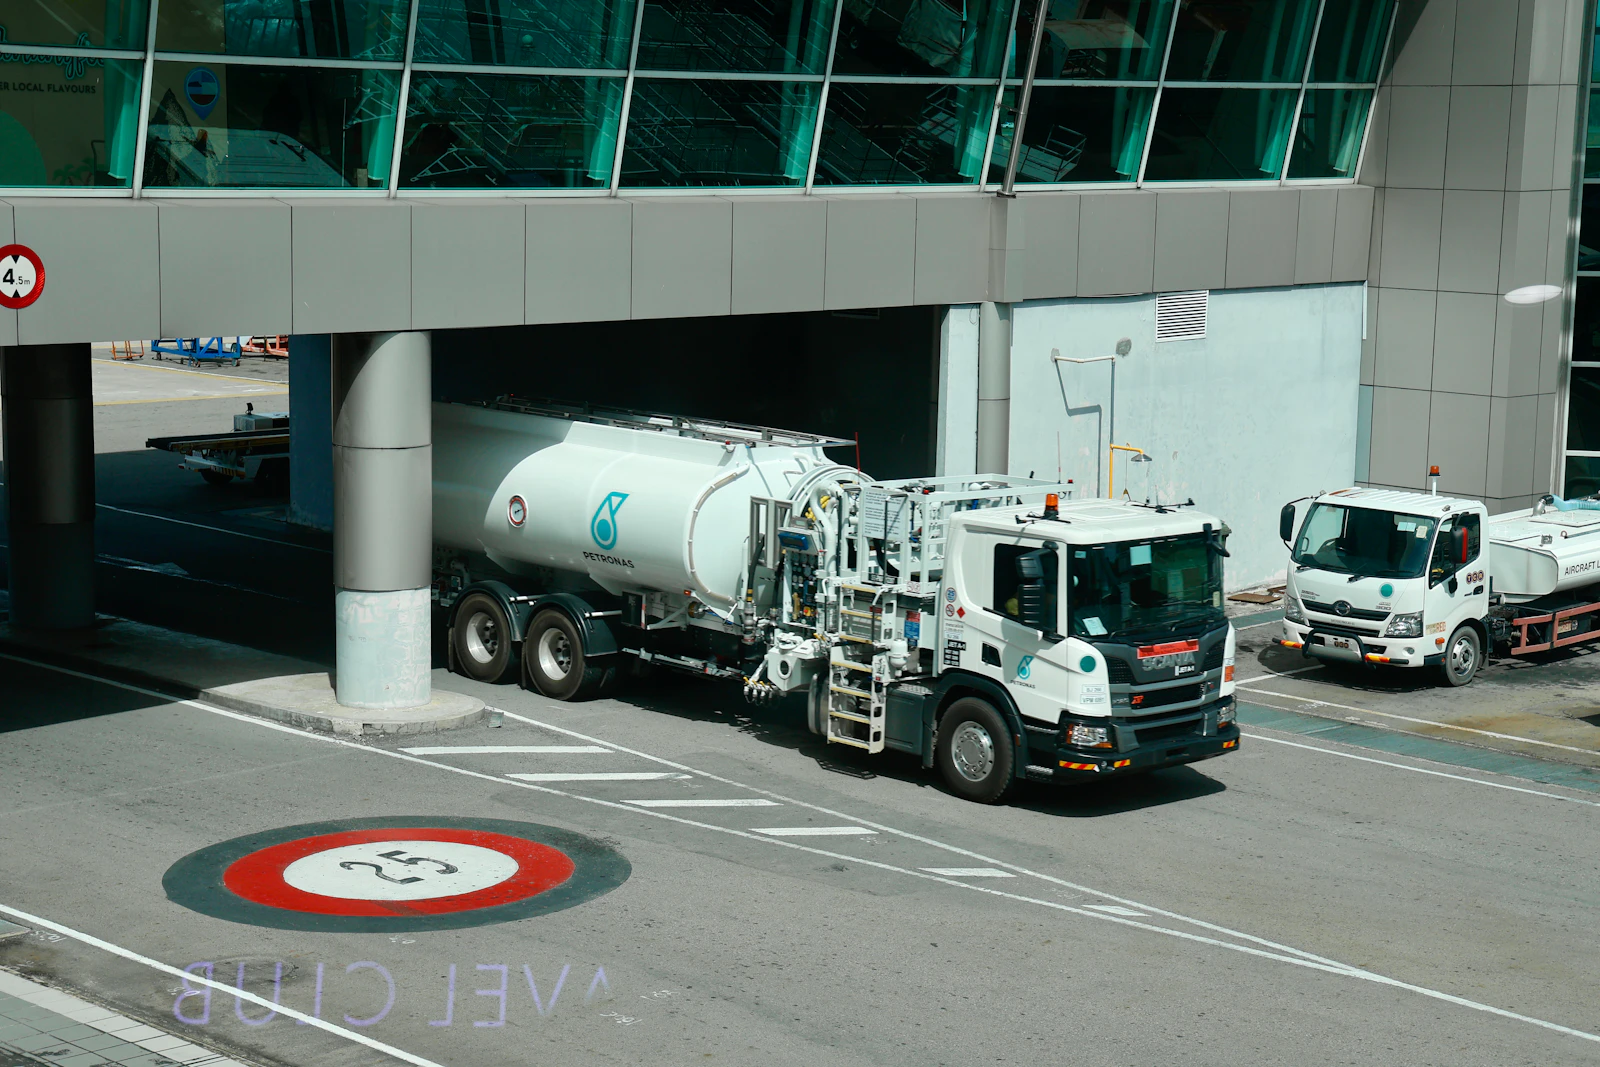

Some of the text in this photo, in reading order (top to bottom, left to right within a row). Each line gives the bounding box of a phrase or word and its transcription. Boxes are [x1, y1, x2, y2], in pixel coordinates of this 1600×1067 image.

[12, 82, 44, 92] LOCAL
[47, 83, 96, 94] FLAVOURS
[582, 551, 635, 569] PETRONAS
[1564, 560, 1596, 576] AIRCRAFT
[1142, 652, 1196, 671] SCANIA
[339, 850, 459, 885] 25
